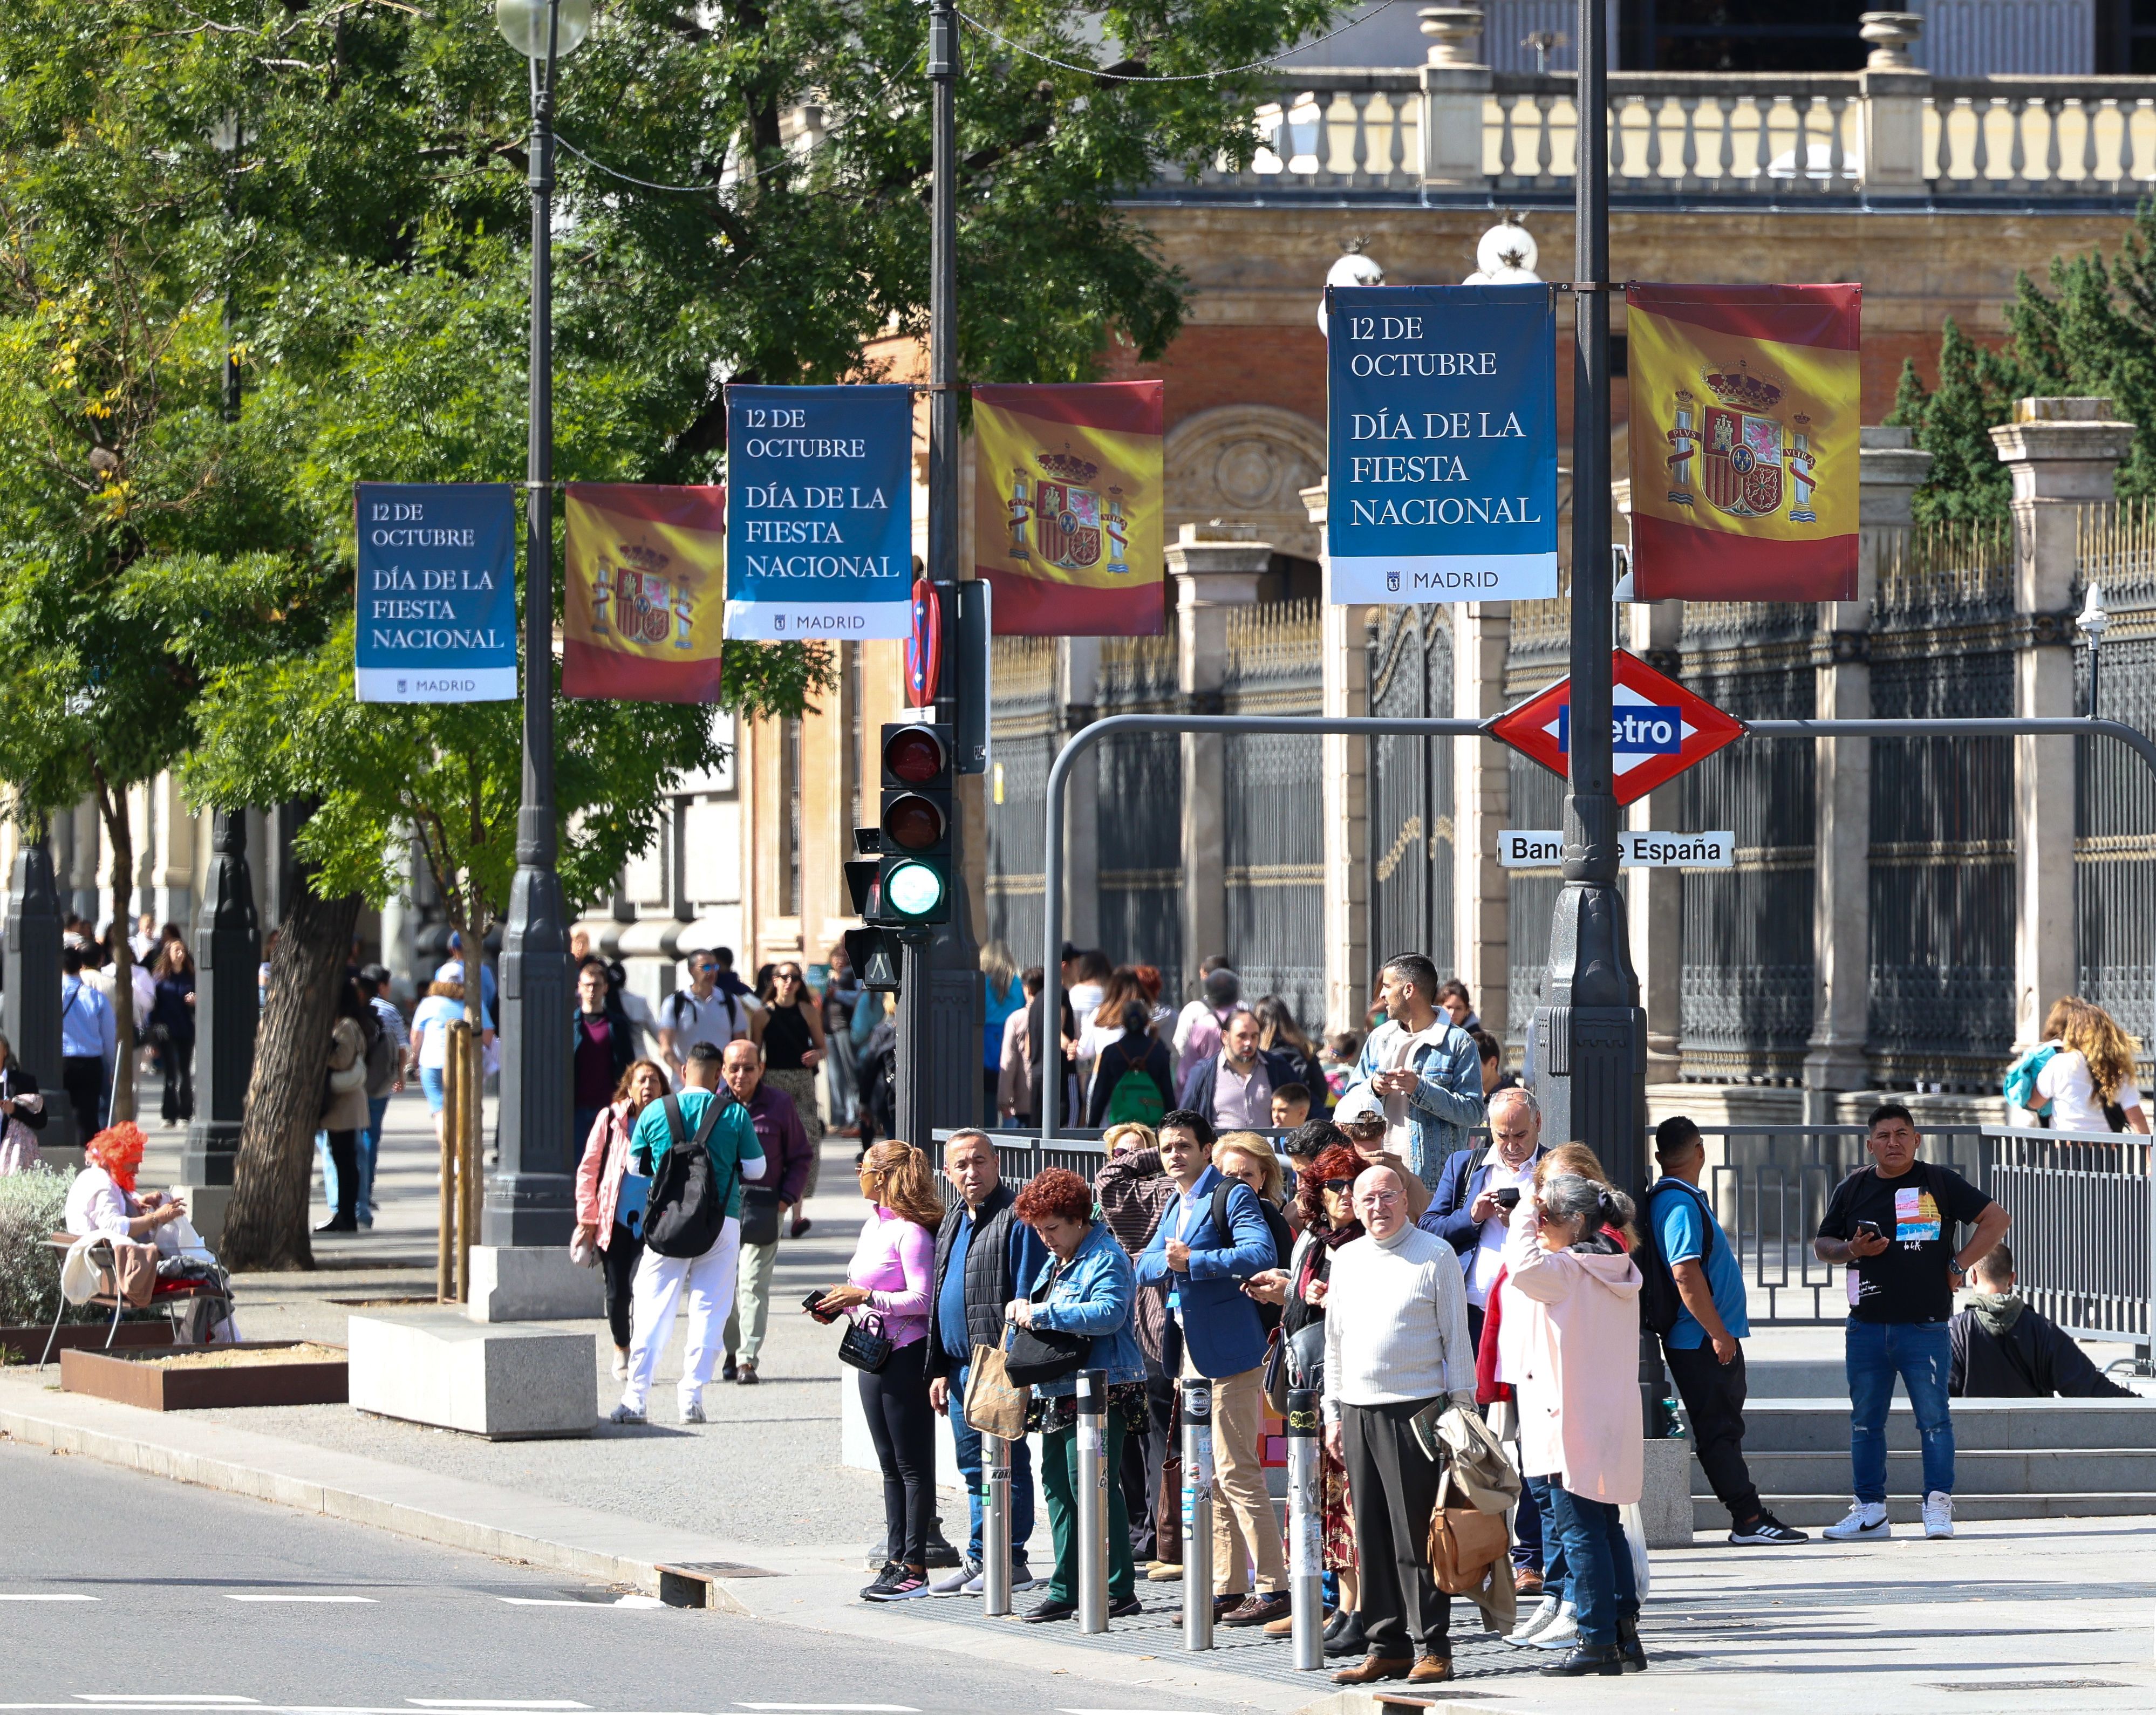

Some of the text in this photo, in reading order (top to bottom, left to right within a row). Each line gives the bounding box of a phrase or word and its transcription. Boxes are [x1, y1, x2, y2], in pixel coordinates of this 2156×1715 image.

[1350, 318, 1423, 339] 12 DE
[1352, 353, 1496, 376] OCTUBRE
[747, 410, 805, 427] 12 DE
[1351, 407, 1526, 439] DÍA DE LA
[1673, 429, 1696, 439] PLVS
[747, 439, 864, 457] OCTUBRE
[1785, 448, 1814, 465] VLTRA
[1350, 456, 1470, 482] FIESTA
[746, 482, 888, 508] DÍA DE LA
[373, 504, 422, 521] 12 DE
[1350, 498, 1540, 525] NACIONAL
[373, 530, 474, 545] OCTUBRE
[746, 522, 843, 543] FIESTA
[747, 556, 899, 577] NACIONAL
[373, 566, 493, 590] DÍA DE LA
[1415, 572, 1498, 587] MADRID
[373, 600, 455, 619] FIESTA
[797, 617, 864, 628] MADRID
[374, 630, 504, 648] NACIONAL
[417, 680, 475, 691] MADRID
[1612, 715, 1672, 744] etro
[1633, 838, 1721, 867] España
